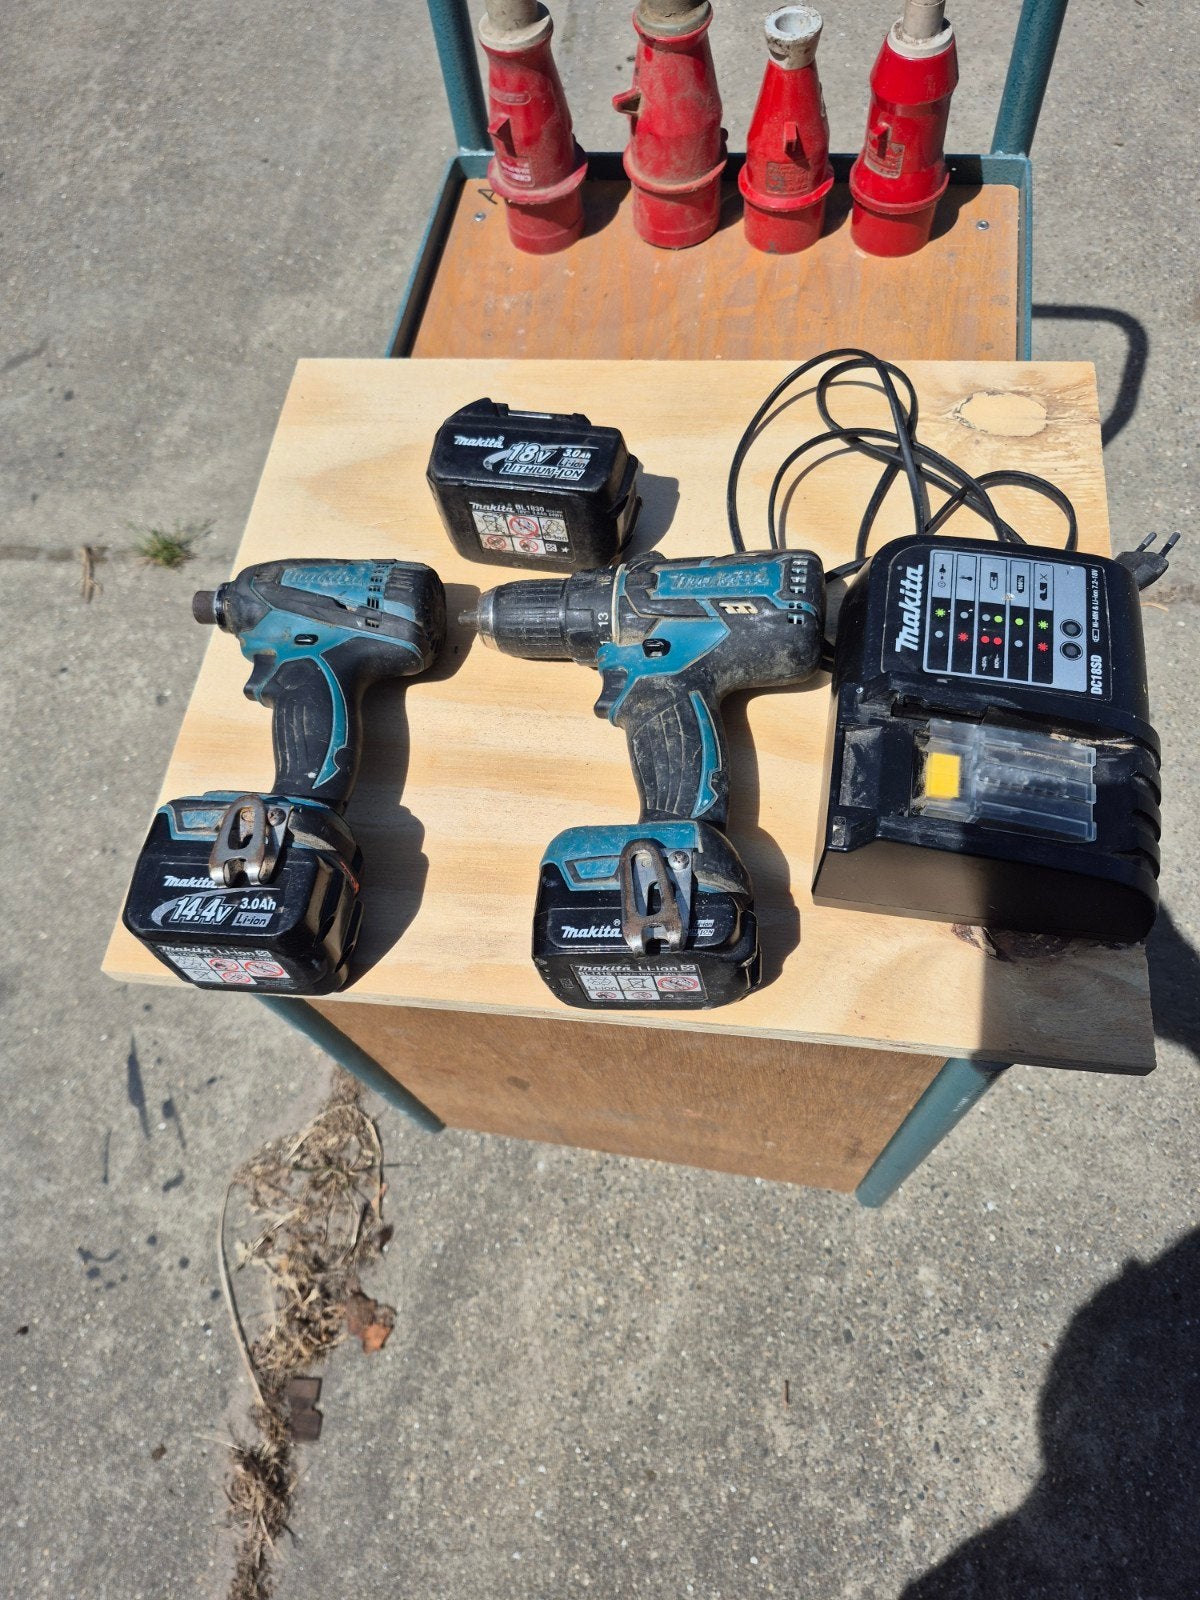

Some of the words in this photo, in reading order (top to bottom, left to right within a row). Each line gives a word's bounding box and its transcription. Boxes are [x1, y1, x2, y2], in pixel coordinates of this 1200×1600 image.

[598, 612, 609, 628] 13
[1090, 654, 1103, 695] DC18SD
[239, 898, 277, 910] 3.0Ah
